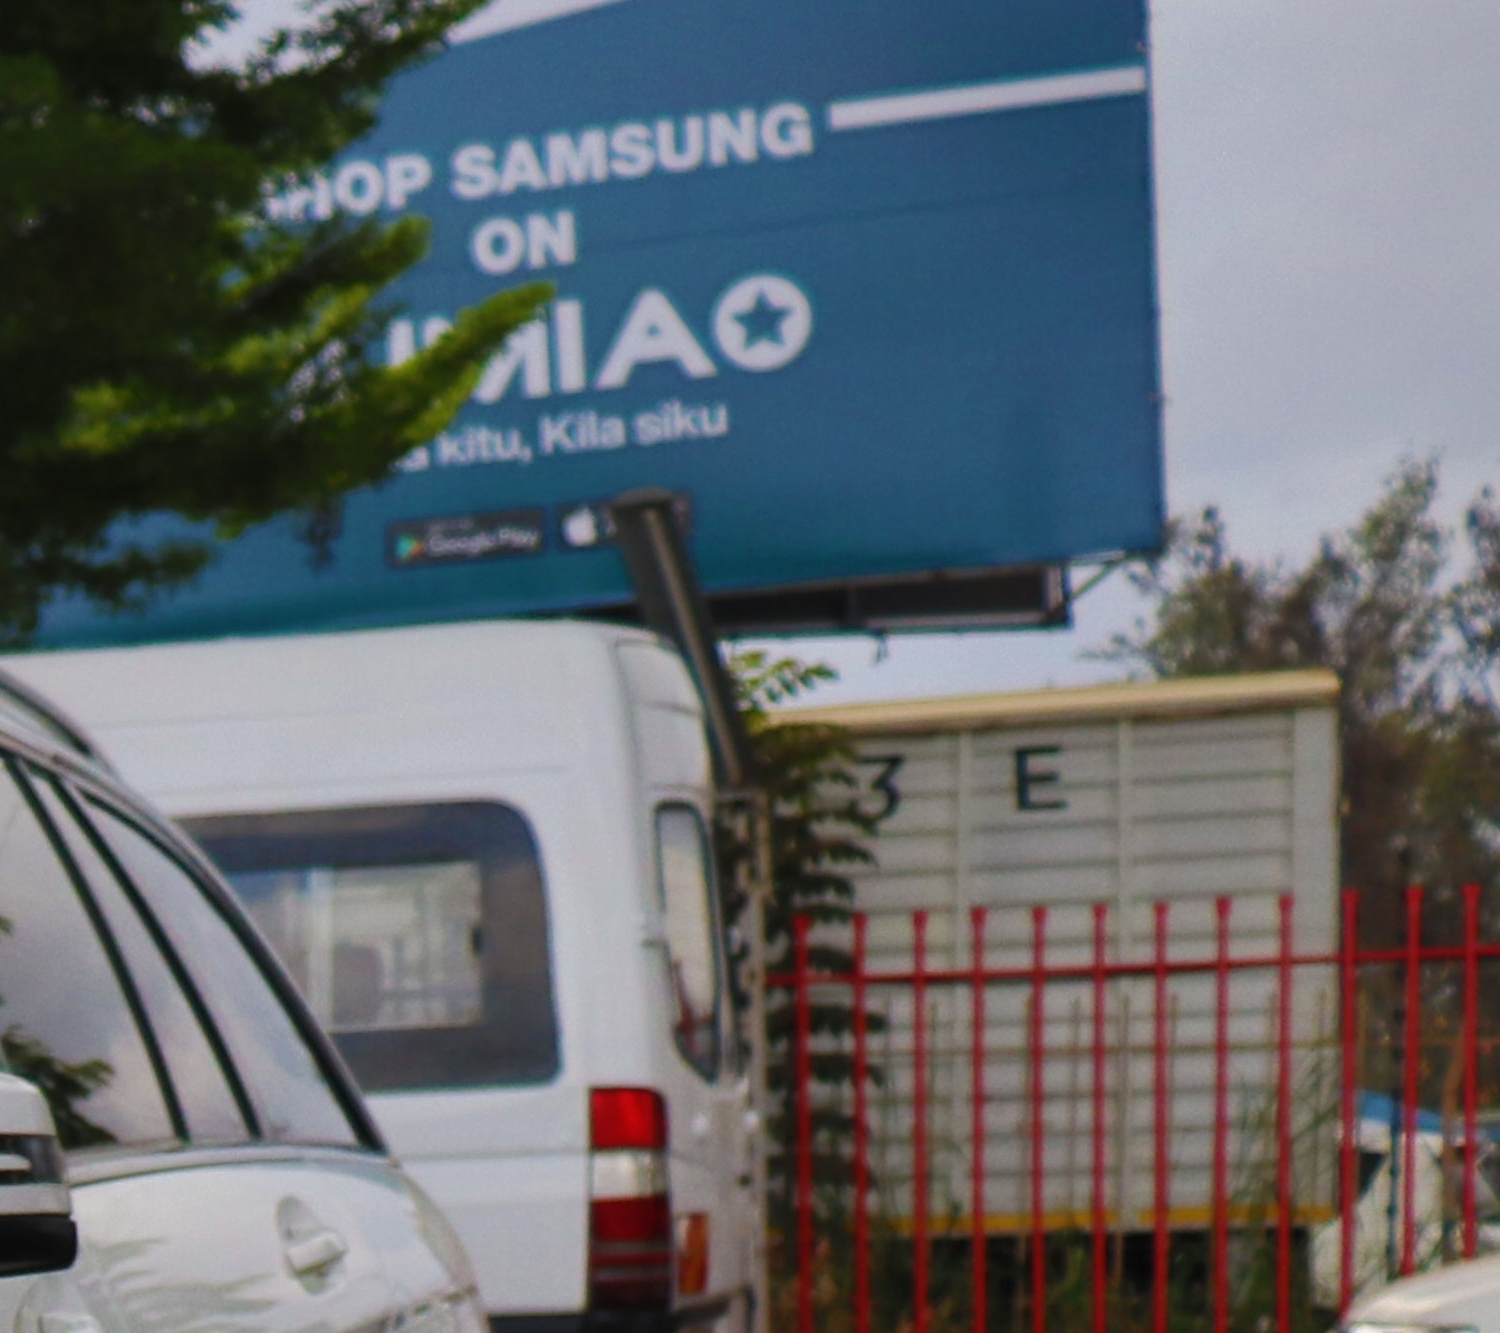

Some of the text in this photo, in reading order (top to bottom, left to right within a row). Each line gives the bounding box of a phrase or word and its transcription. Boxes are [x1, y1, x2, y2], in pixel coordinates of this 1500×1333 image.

[452, 102, 814, 198] SAMSUNG
[472, 211, 578, 275] ON
[540, 411, 626, 454] Kila
[636, 400, 729, 446] siku
[1014, 745, 1068, 812] E
